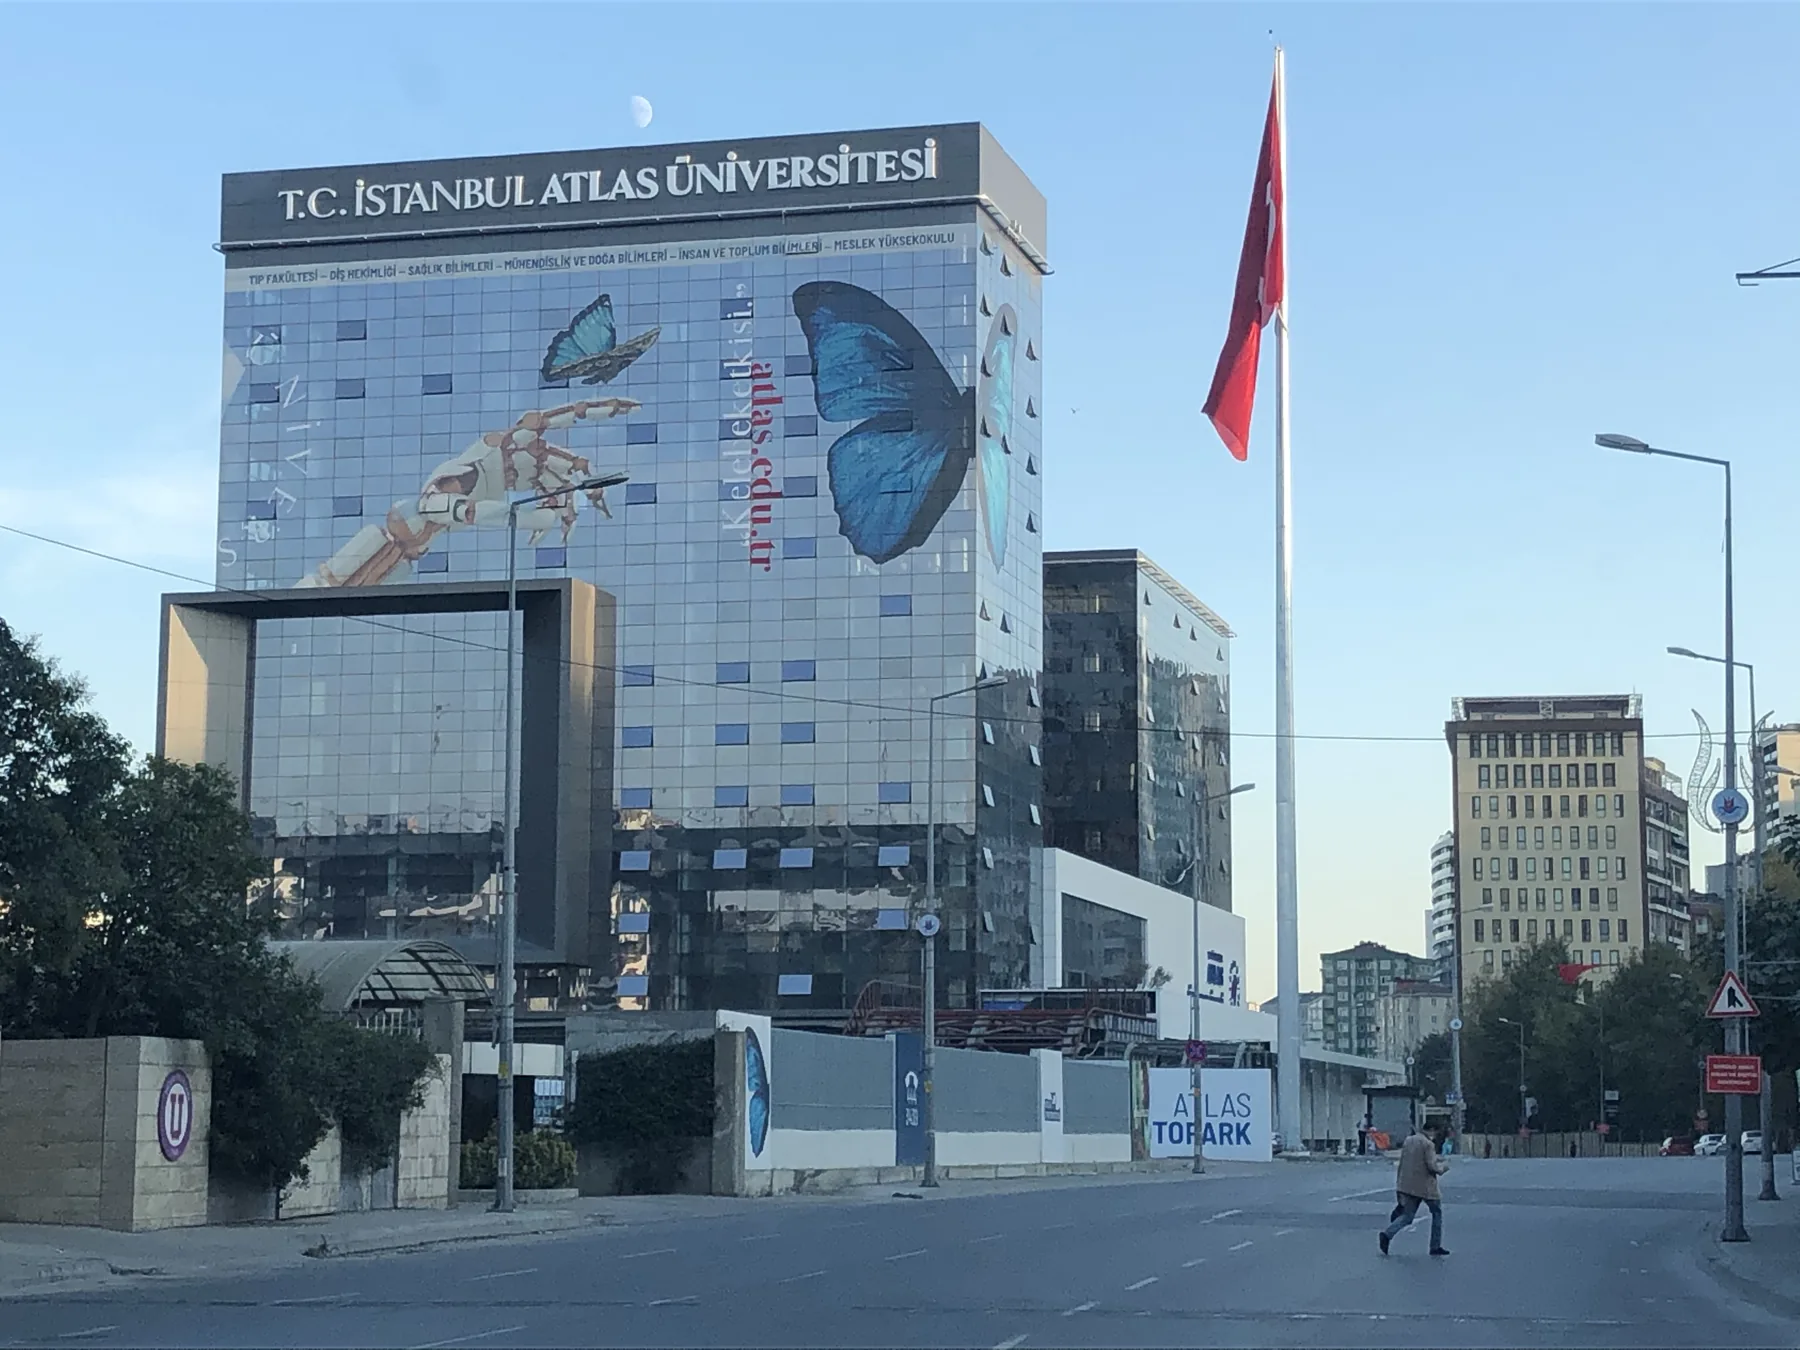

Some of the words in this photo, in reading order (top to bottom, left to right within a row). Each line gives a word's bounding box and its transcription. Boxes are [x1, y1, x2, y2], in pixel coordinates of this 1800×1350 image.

[278, 187, 347, 220] T.C.
[354, 176, 534, 217] İSTANBUL
[538, 167, 660, 206] ATLAS
[266, 268, 319, 285] FAKÜLTESİ
[329, 268, 346, 283] DİŞ
[348, 264, 397, 280] HEKİMLİĞİ
[407, 263, 443, 277] SAĞLIK
[445, 259, 494, 274] BİLİMLERİ
[504, 254, 572, 271] MÜHENDİSLİK
[573, 255, 587, 267] VE
[588, 252, 616, 266] DOĞA
[618, 249, 668, 264] BİLİMLERİ
[678, 246, 711, 261] İNSAN
[712, 247, 726, 259] VE
[729, 243, 771, 258] TOPLUM
[772, 238, 822, 255] BİLİMLERİ
[834, 237, 876, 252] MESLEK
[878, 231, 955, 249] YÜKSEKOKULU
[750, 363, 784, 573] atlas.edu.tr
[1173, 1092, 1252, 1118] ALAS
